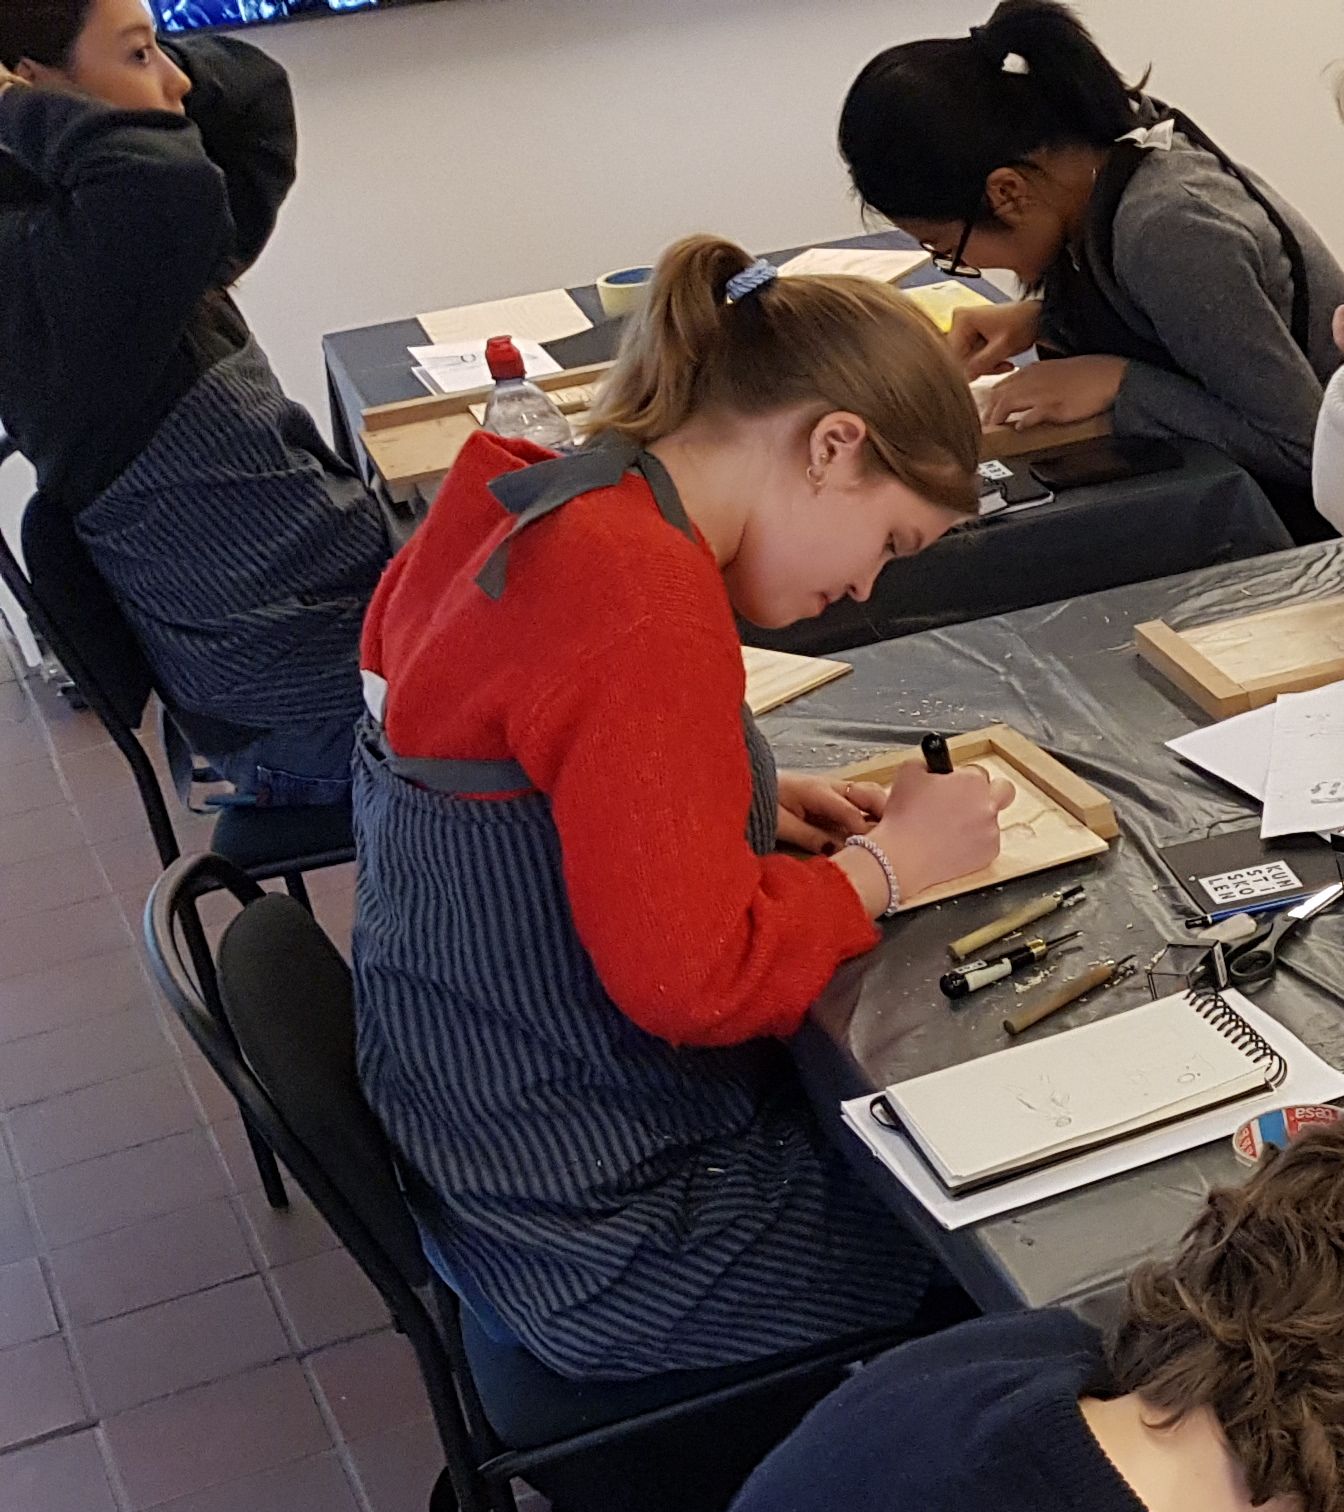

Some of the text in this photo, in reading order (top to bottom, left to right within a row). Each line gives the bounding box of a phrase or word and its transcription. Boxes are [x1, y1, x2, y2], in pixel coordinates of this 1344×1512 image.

[1227, 873, 1253, 895] SKO
[1265, 865, 1294, 887] KUN
[1208, 877, 1235, 899] LEN
[1295, 1108, 1332, 1121] tesa
